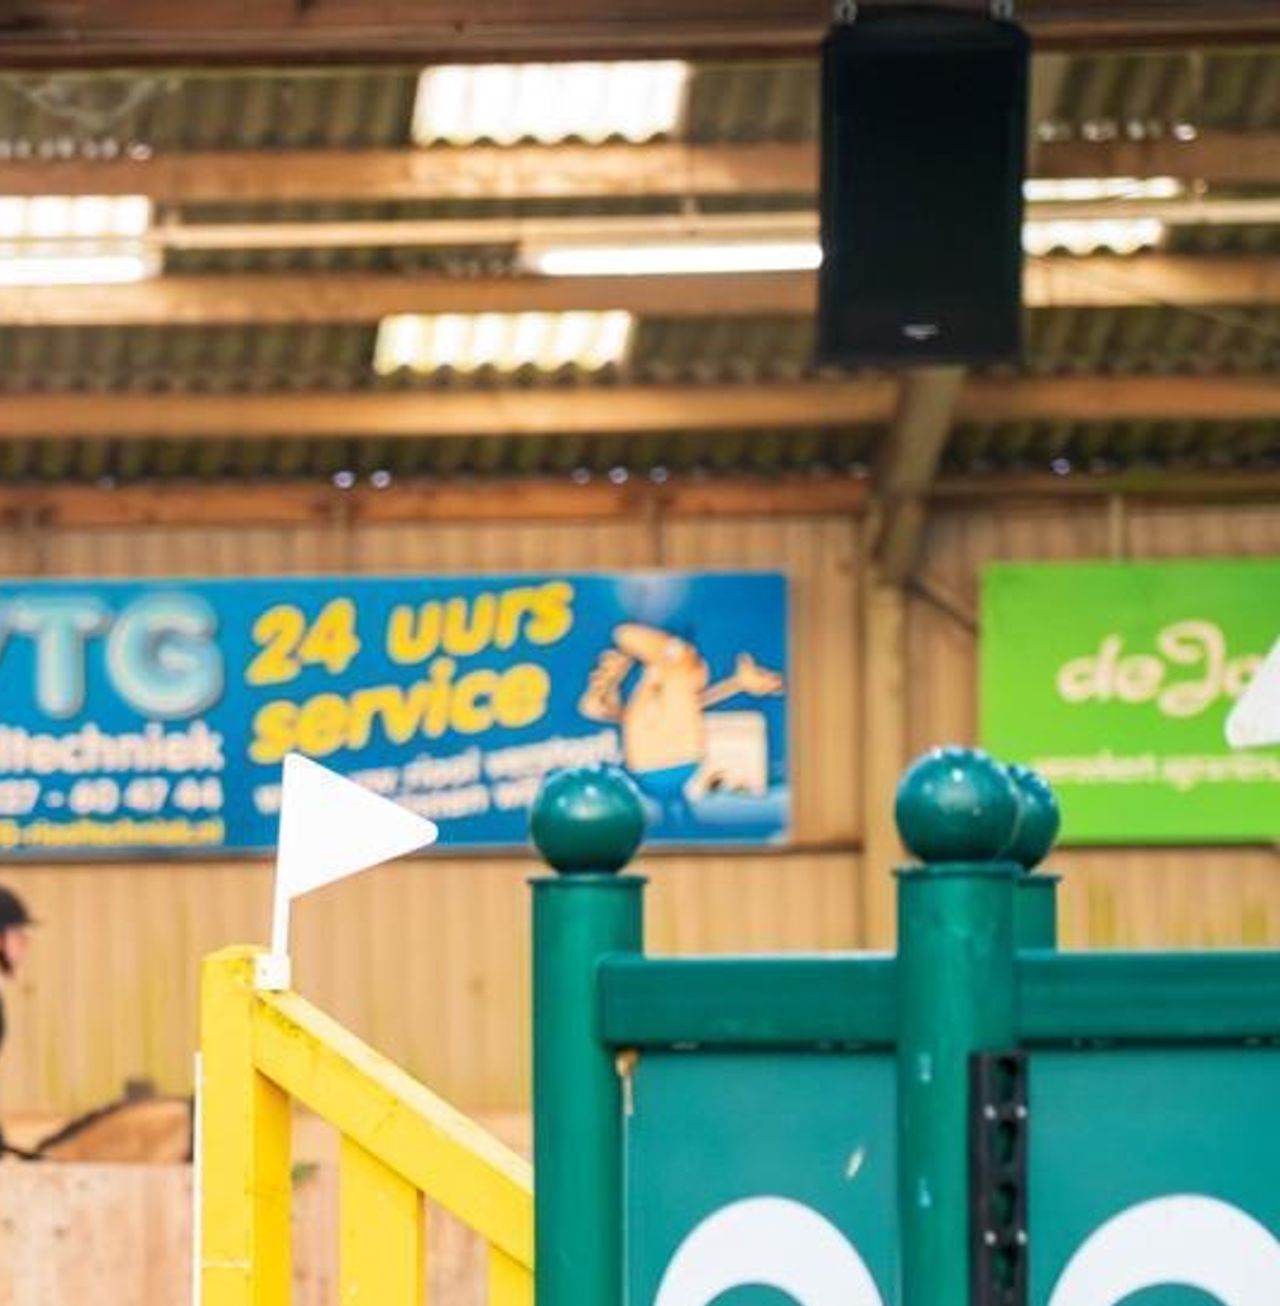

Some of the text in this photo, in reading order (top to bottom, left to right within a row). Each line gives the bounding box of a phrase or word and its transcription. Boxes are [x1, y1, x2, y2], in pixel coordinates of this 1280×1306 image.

[247, 581, 573, 686] 24 uurs
[248, 658, 551, 767] service
